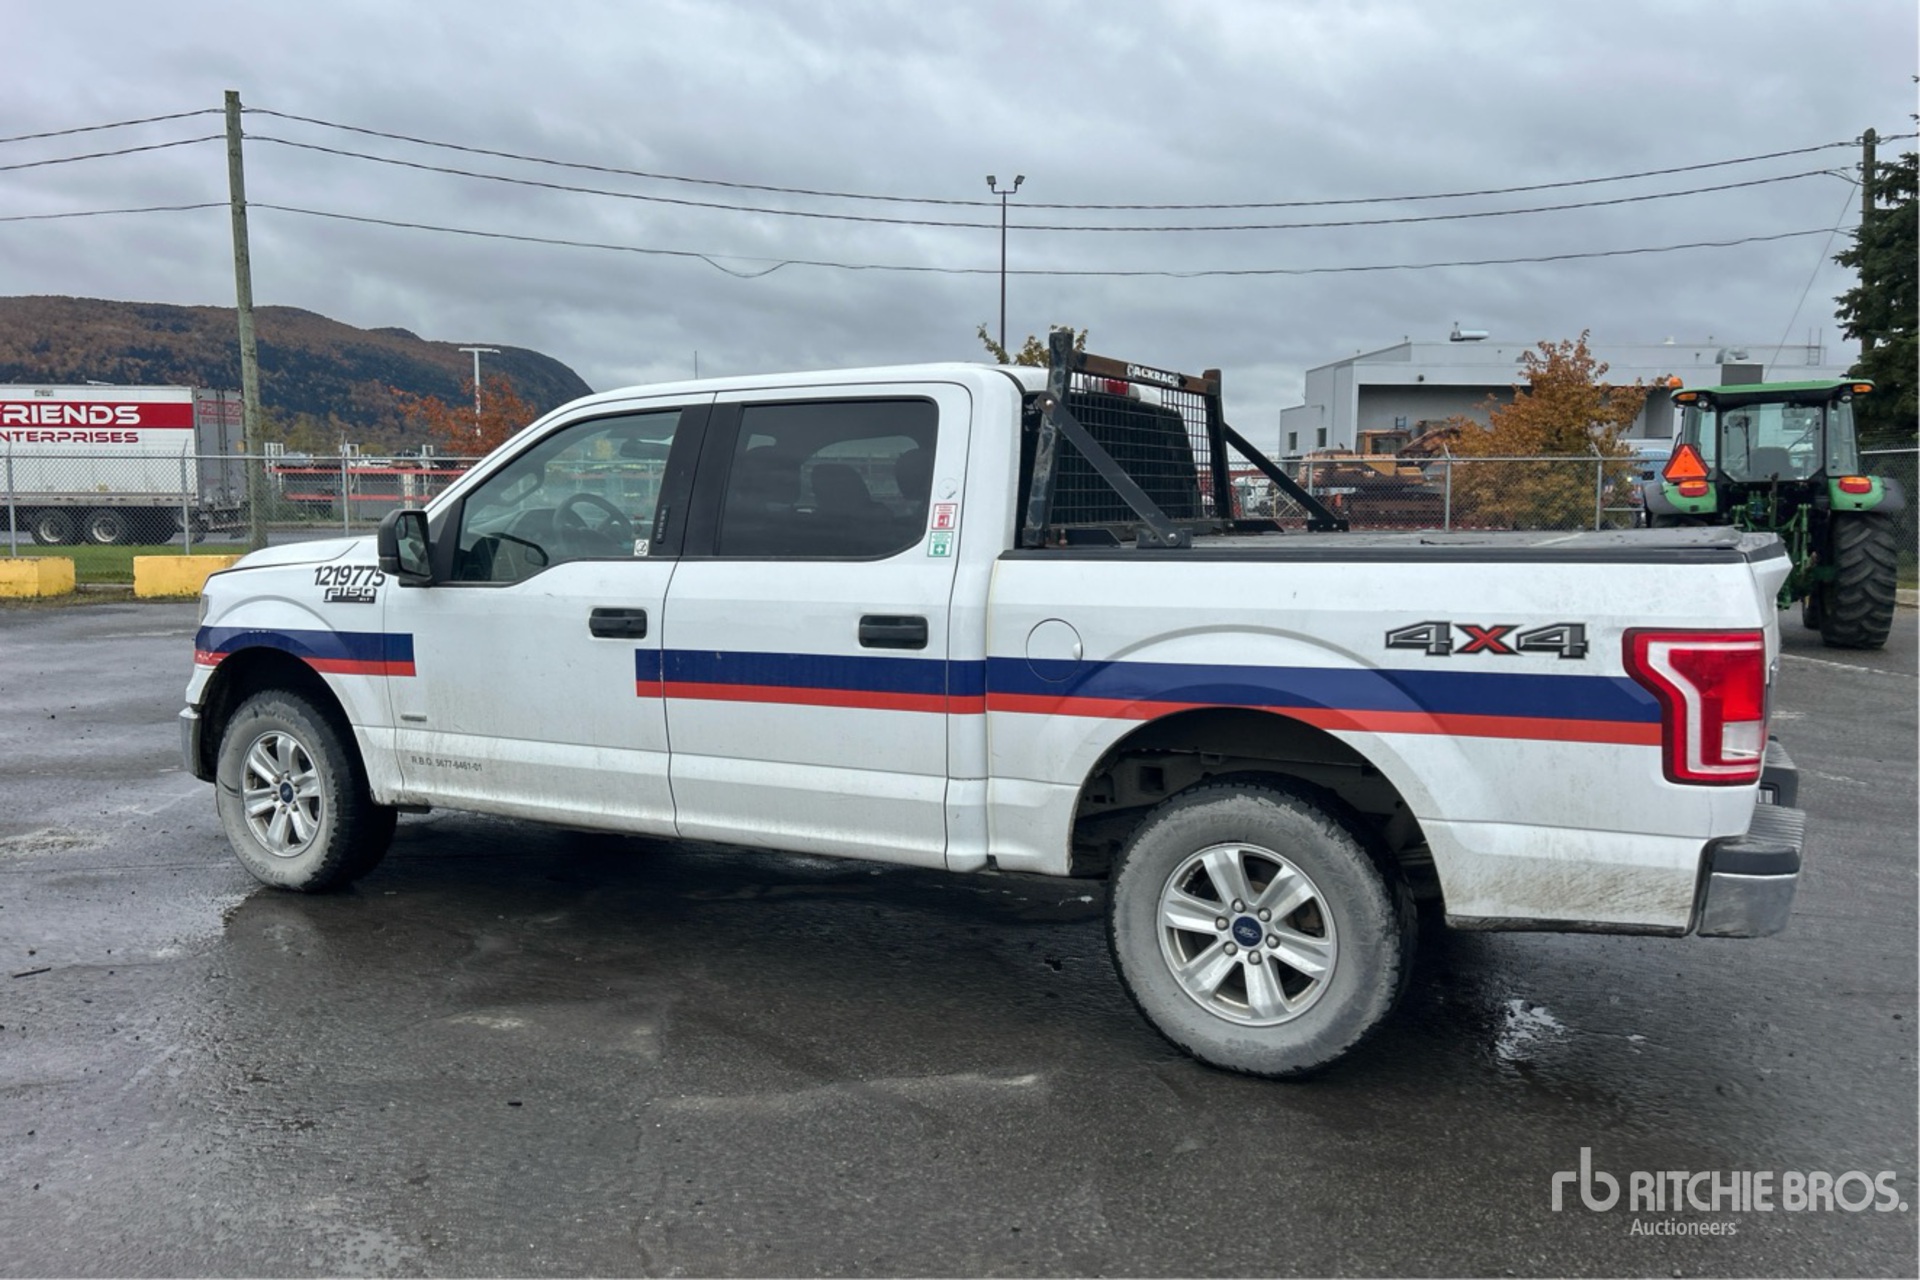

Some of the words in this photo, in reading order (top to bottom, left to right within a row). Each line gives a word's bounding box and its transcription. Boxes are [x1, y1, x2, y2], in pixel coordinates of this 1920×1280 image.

[0, 404, 140, 424] RIENDS
[0, 431, 139, 443] NTERPRISES
[314, 565, 386, 587] 1219775
